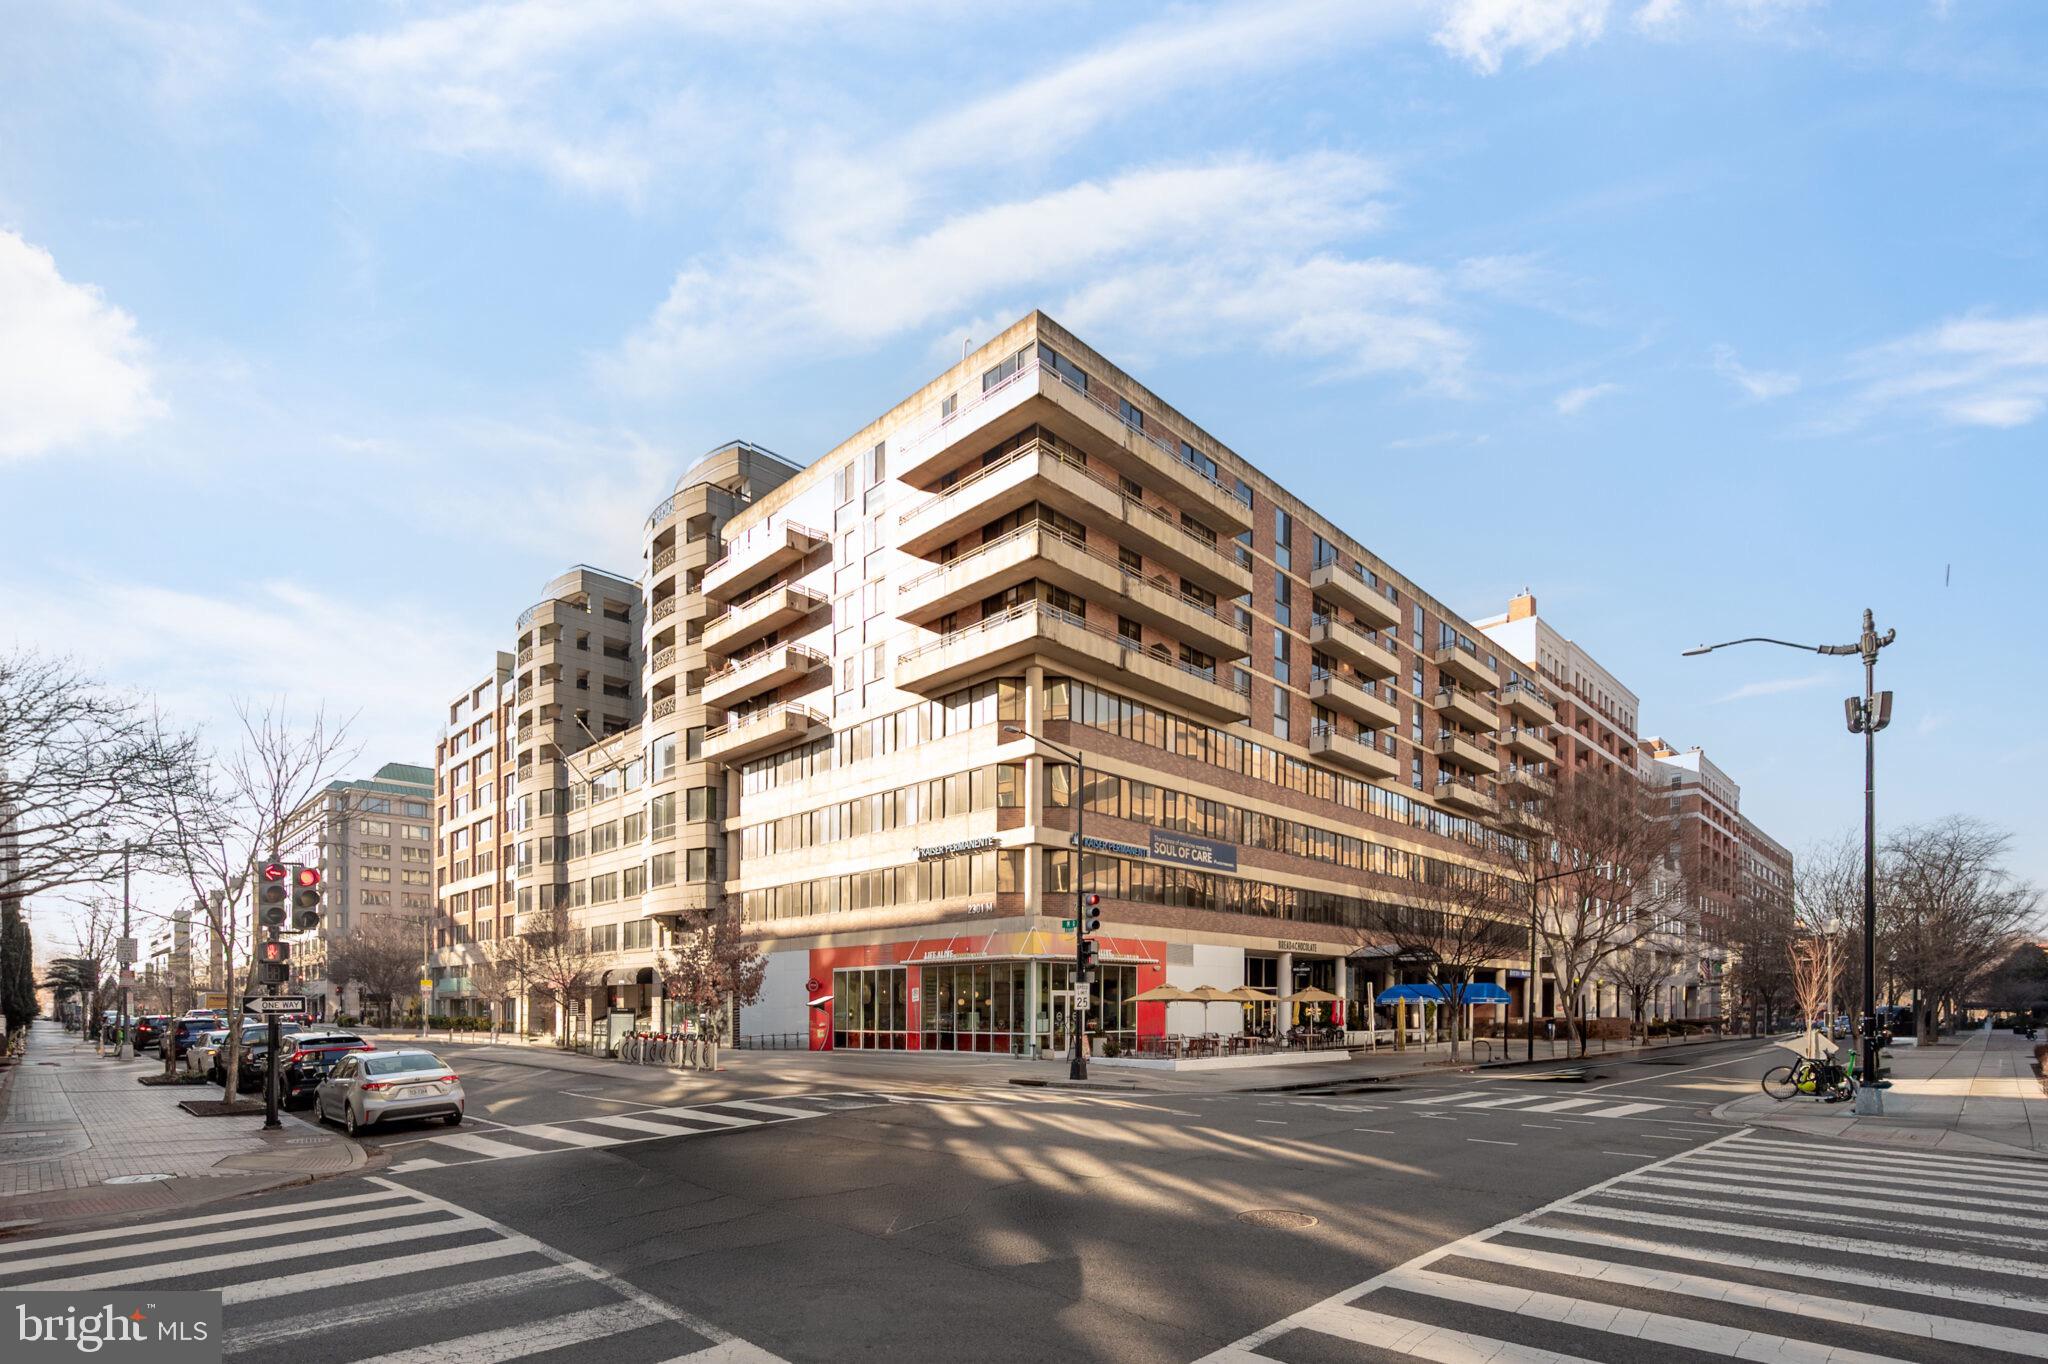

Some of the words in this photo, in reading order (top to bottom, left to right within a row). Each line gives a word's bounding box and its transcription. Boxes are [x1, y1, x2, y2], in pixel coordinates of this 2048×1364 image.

[920, 845, 944, 857] KAISER
[945, 837, 993, 853] PERMANENTE
[1084, 837, 1107, 849] KAISER
[1154, 842, 1177, 857] SOUL
[1178, 847, 1190, 860] OF
[1191, 849, 1213, 864] CARE
[968, 903, 984, 914] 2301
[986, 902, 993, 912] M
[262, 1001, 280, 1009] ONE
[282, 1001, 299, 1009] WAY
[1077, 997, 1088, 1008] 25
